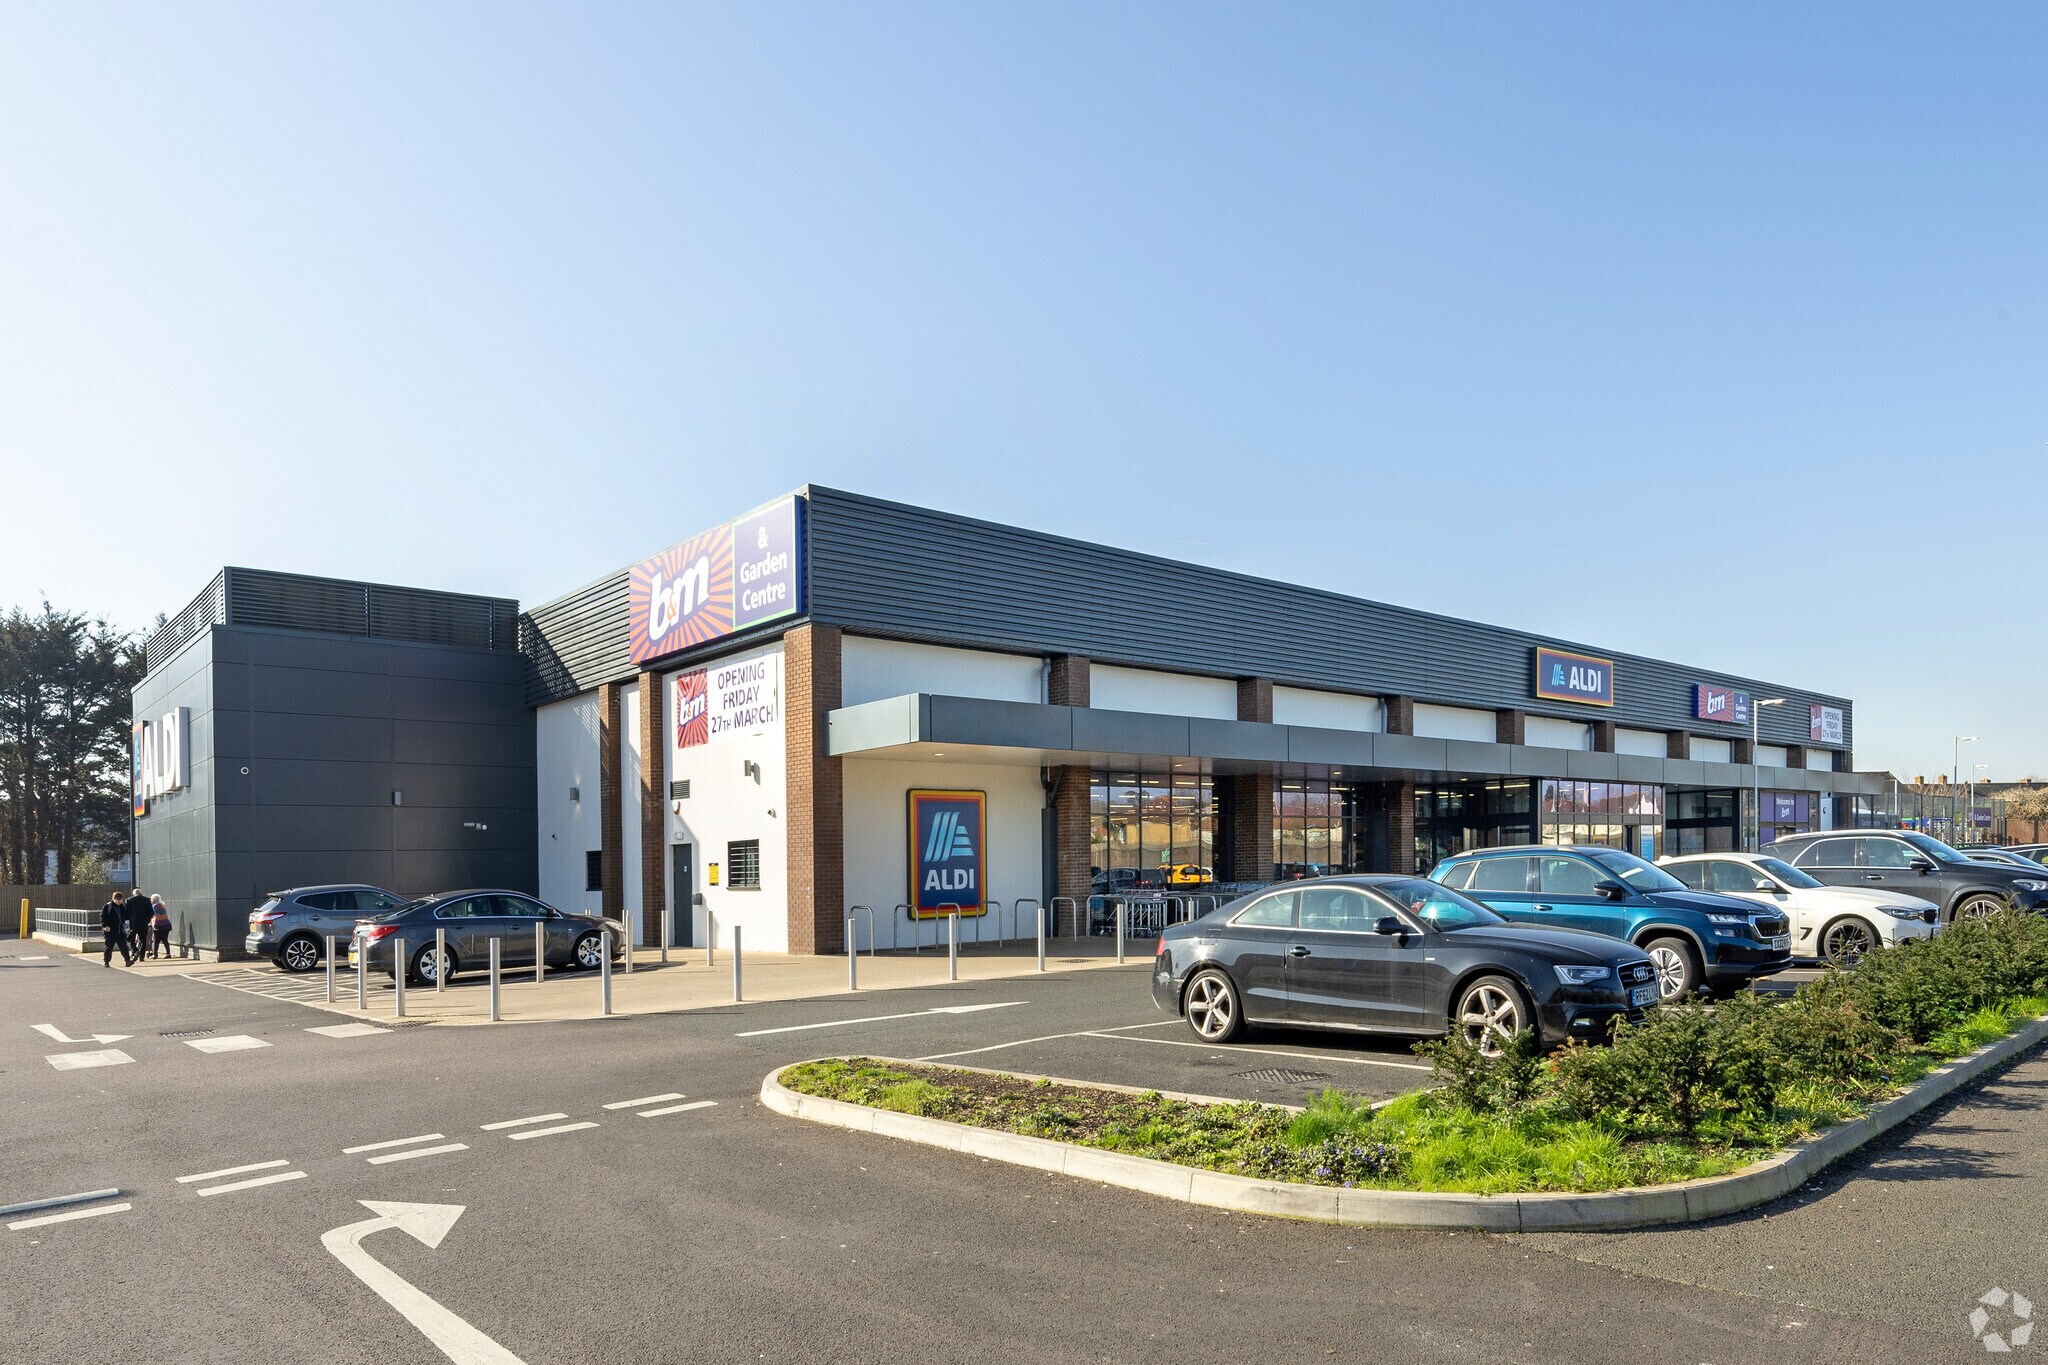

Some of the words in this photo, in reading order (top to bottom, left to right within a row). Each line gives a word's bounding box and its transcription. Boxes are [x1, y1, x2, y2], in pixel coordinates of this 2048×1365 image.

[758, 526, 768, 549] &
[740, 551, 787, 584] Garden
[742, 582, 786, 611] Centre
[718, 661, 765, 690] OPENING
[1569, 666, 1601, 693] ALDI
[723, 685, 760, 710] FRIDAY
[734, 704, 774, 729] MARCH
[143, 706, 186, 800] ALDI
[924, 868, 975, 890] ALDI
